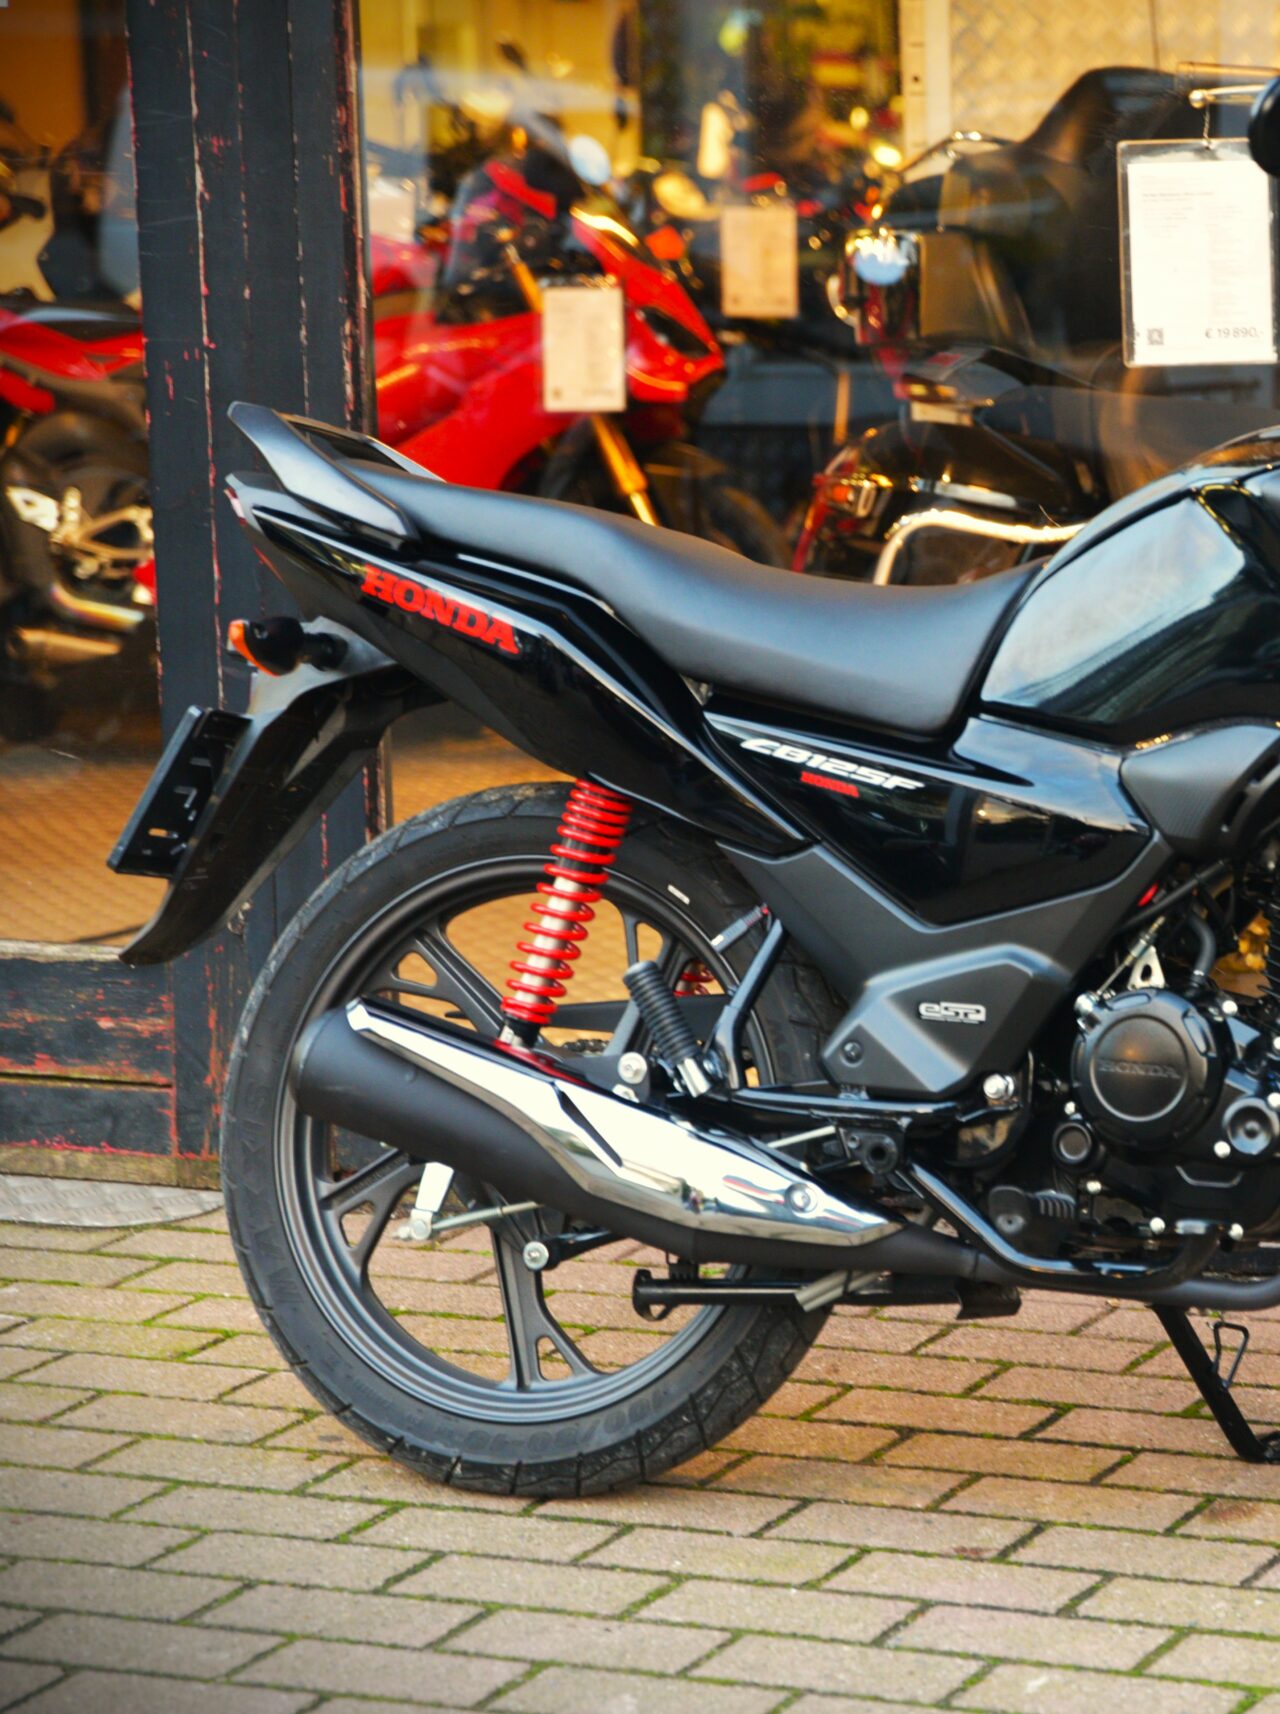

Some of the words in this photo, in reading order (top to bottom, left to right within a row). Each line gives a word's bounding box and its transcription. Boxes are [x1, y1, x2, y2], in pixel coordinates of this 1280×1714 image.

[360, 562, 520, 655] HONDA
[740, 738, 926, 790] CB125F
[1098, 1059, 1181, 1080] HONDA
